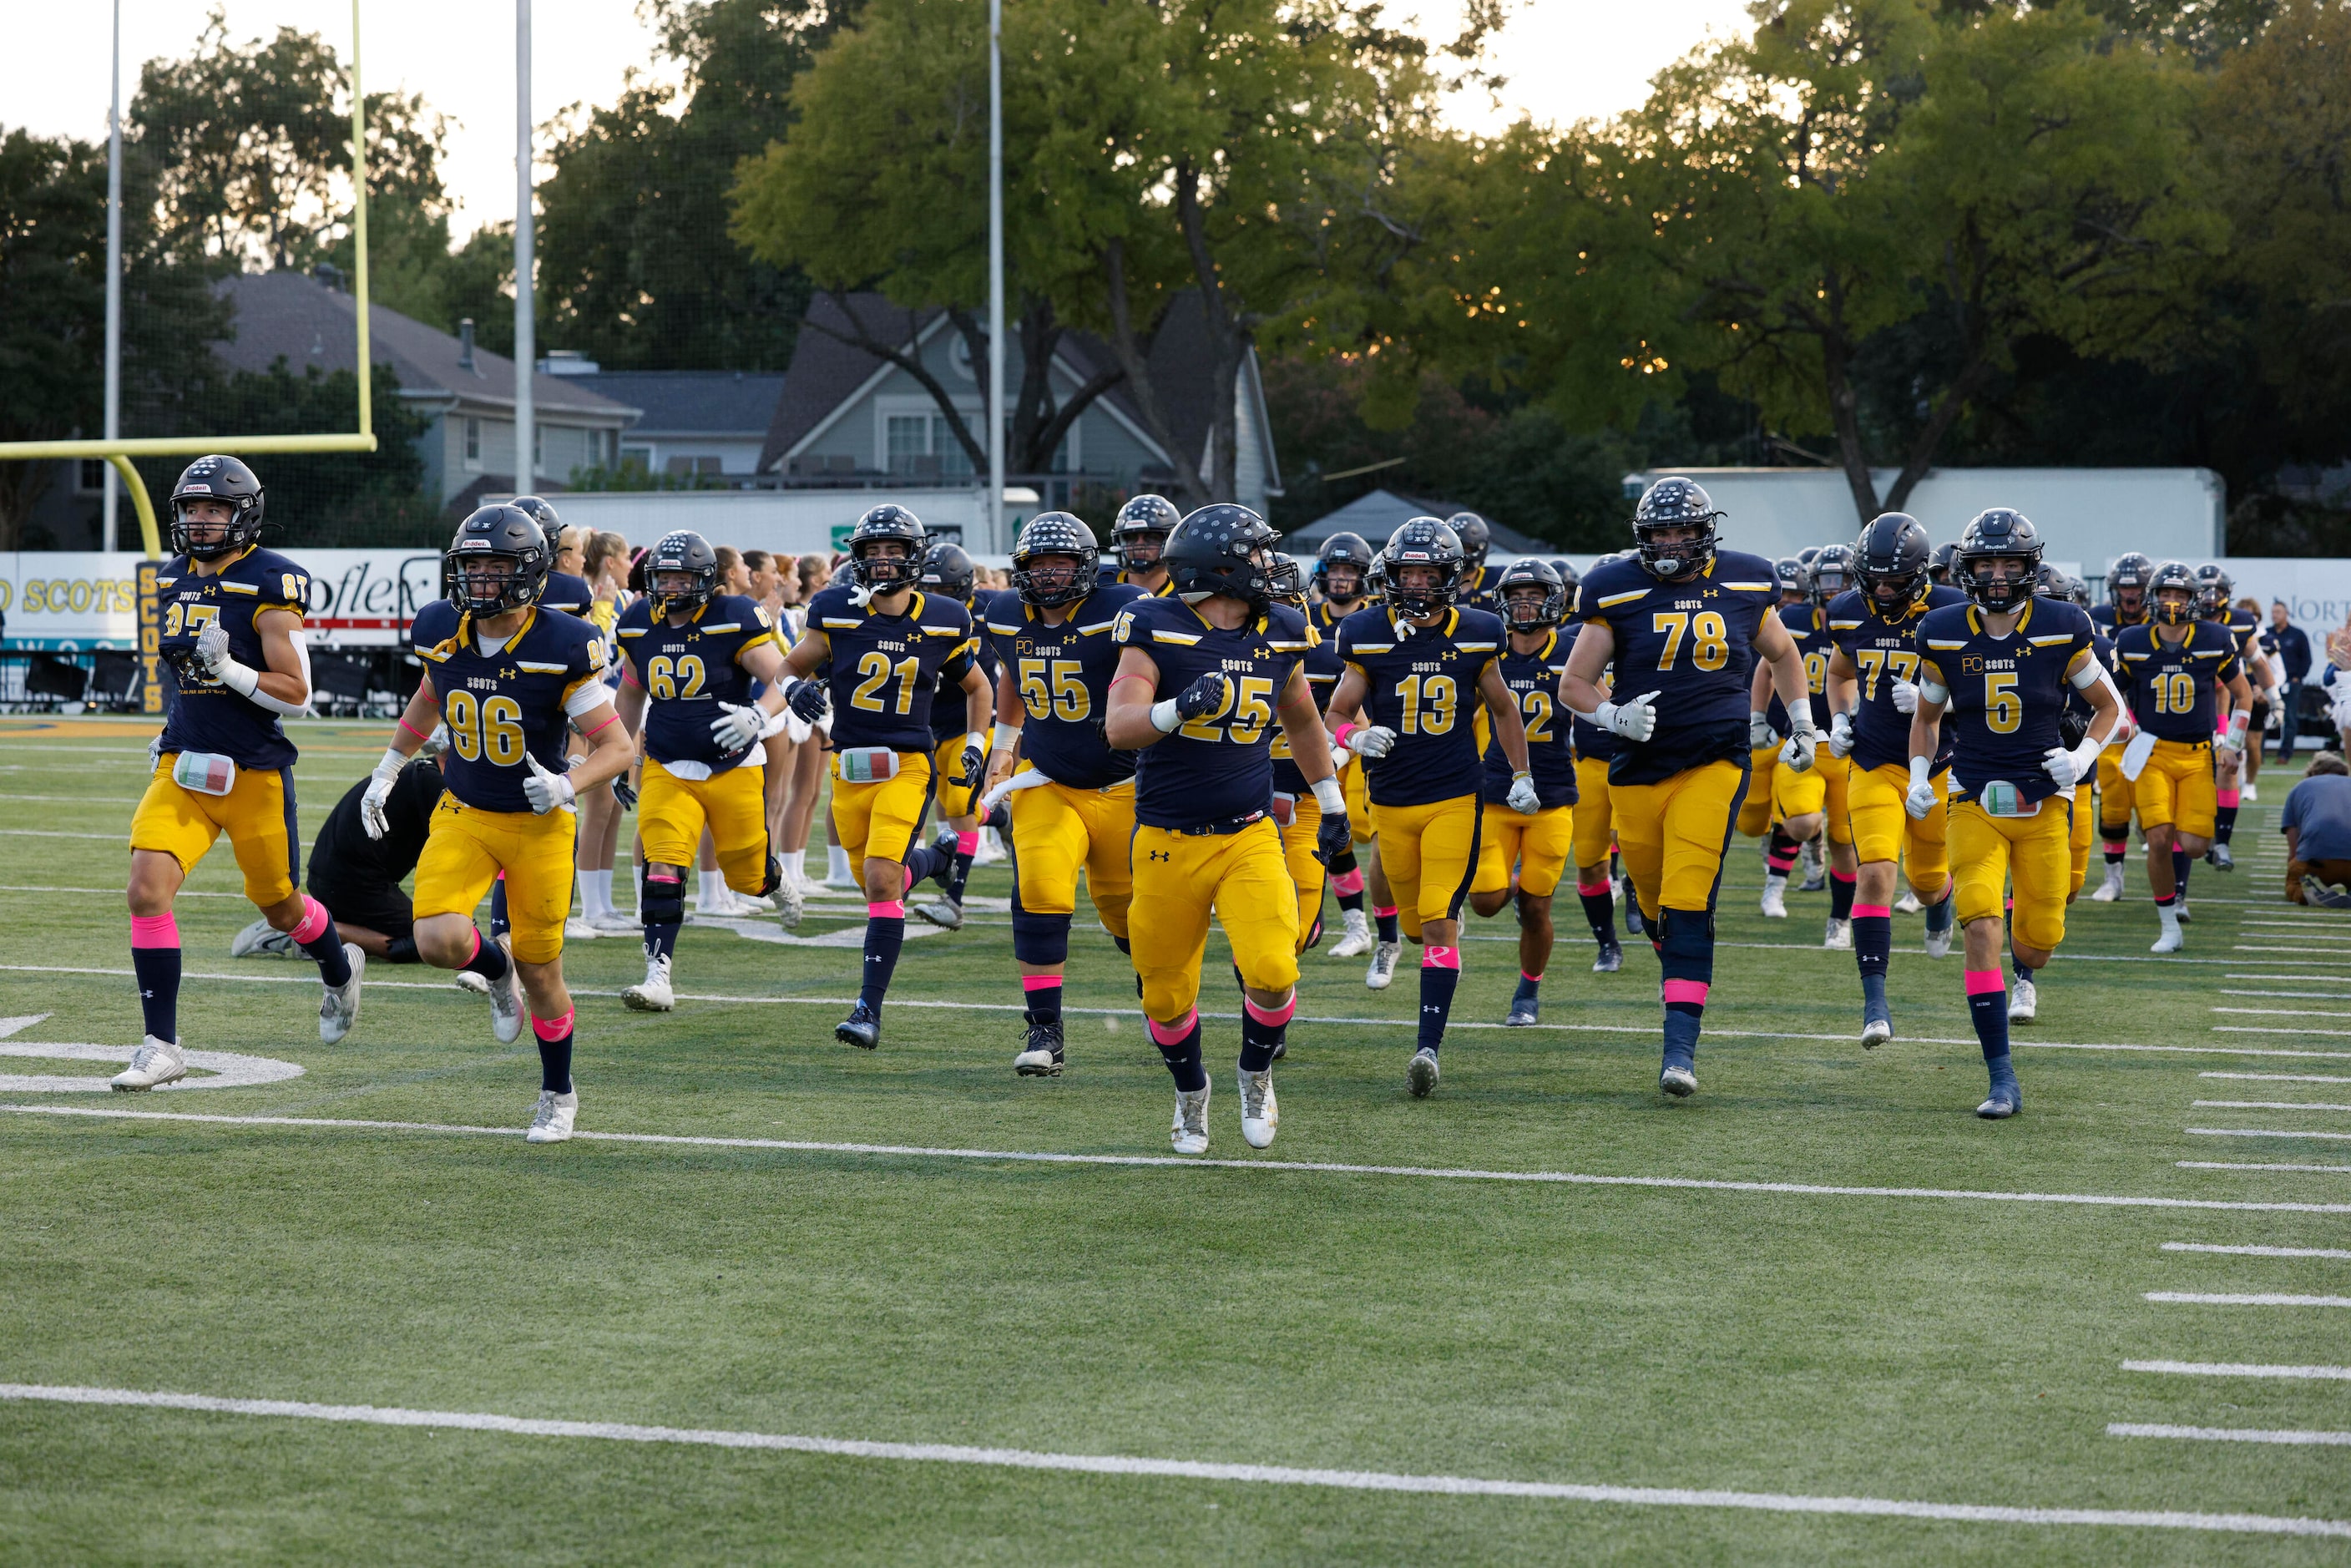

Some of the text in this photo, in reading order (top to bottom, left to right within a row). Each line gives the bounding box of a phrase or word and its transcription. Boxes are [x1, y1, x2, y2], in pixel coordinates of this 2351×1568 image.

[23, 578, 137, 614] SCOTS
[179, 591, 202, 601] SCOTS
[281, 573, 308, 604] 87
[1674, 599, 1703, 610] SCOTS
[139, 566, 163, 713] SCOTS
[1110, 610, 1135, 643] 25
[1652, 610, 1730, 672] 78
[1875, 638, 1900, 648] SCOTS
[662, 644, 685, 653] SCOTS
[877, 640, 906, 652] SCOTS
[1016, 640, 1061, 656] PC SCOTS
[648, 655, 712, 700] 62
[1221, 659, 1253, 672] SCOTS
[1412, 662, 1441, 672] SCOTS
[1856, 649, 1920, 701] 77
[1963, 657, 2015, 673] PC SCOTS
[467, 676, 498, 691] SCOTS
[850, 651, 919, 715] 21
[1019, 659, 1091, 723] 55
[1509, 680, 1535, 690] SCOTS
[2151, 673, 2195, 715] 10
[1178, 671, 1274, 745] 25
[1395, 674, 1458, 736] 13
[1984, 671, 2022, 735] 5
[446, 689, 527, 766] 96
